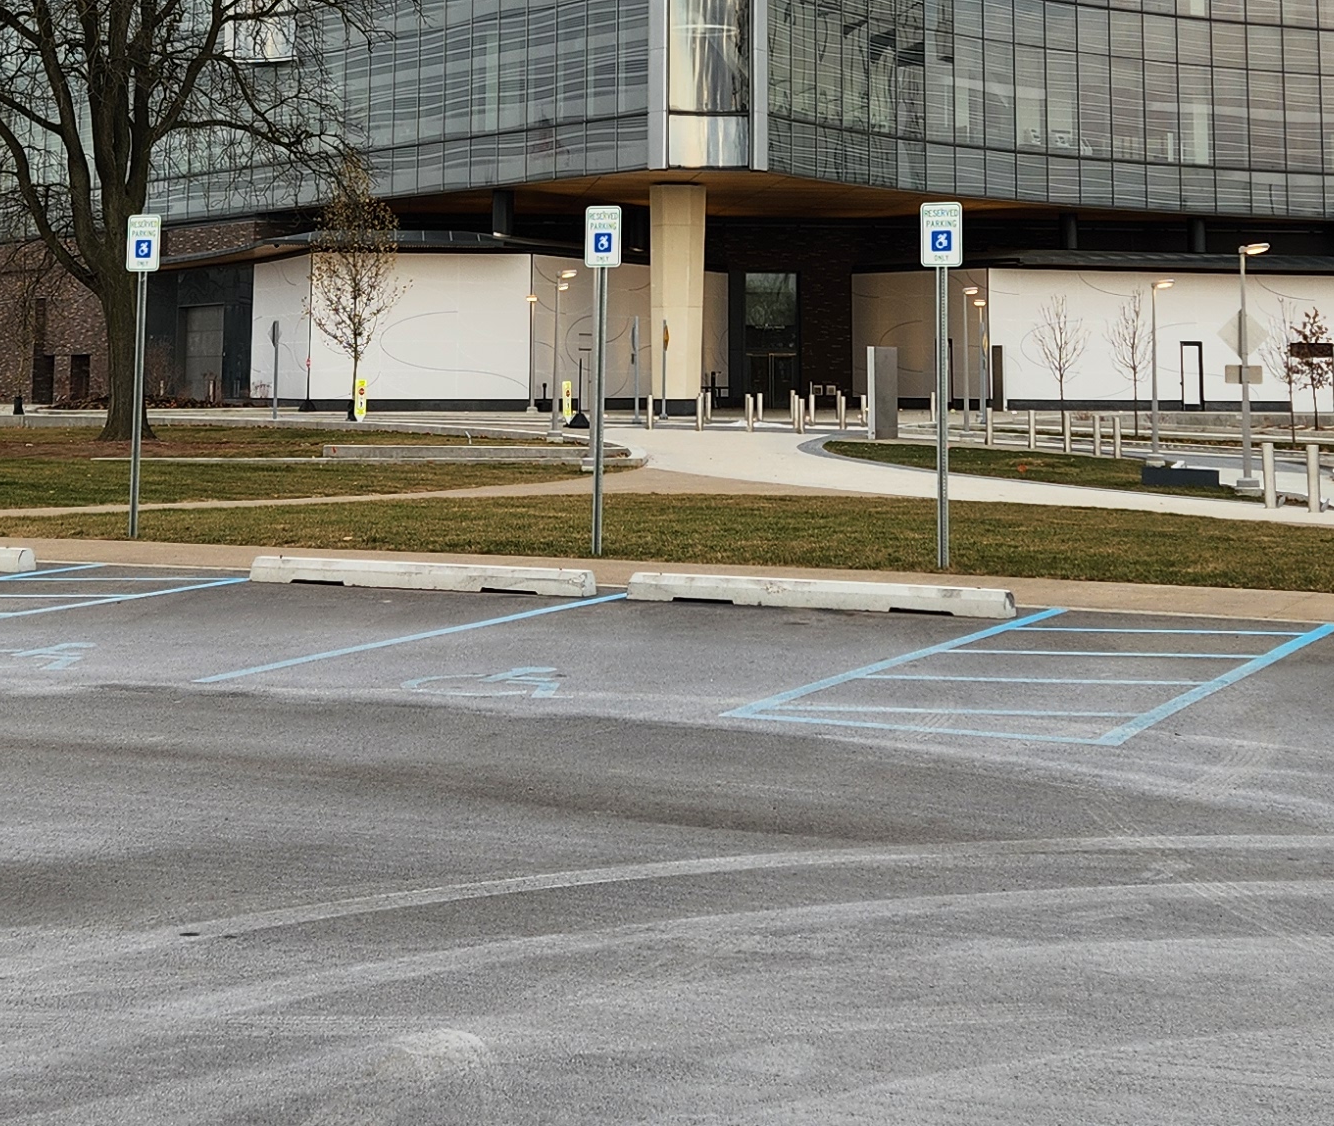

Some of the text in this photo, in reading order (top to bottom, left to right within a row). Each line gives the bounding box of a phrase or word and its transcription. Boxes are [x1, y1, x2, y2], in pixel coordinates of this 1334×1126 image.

[589, 212, 619, 220] RESERVED
[924, 209, 959, 217] RESERVED
[130, 220, 158, 228] RESERVED
[590, 222, 617, 230] PARKING
[926, 220, 957, 228] PARKING
[132, 229, 156, 237] PARKING
